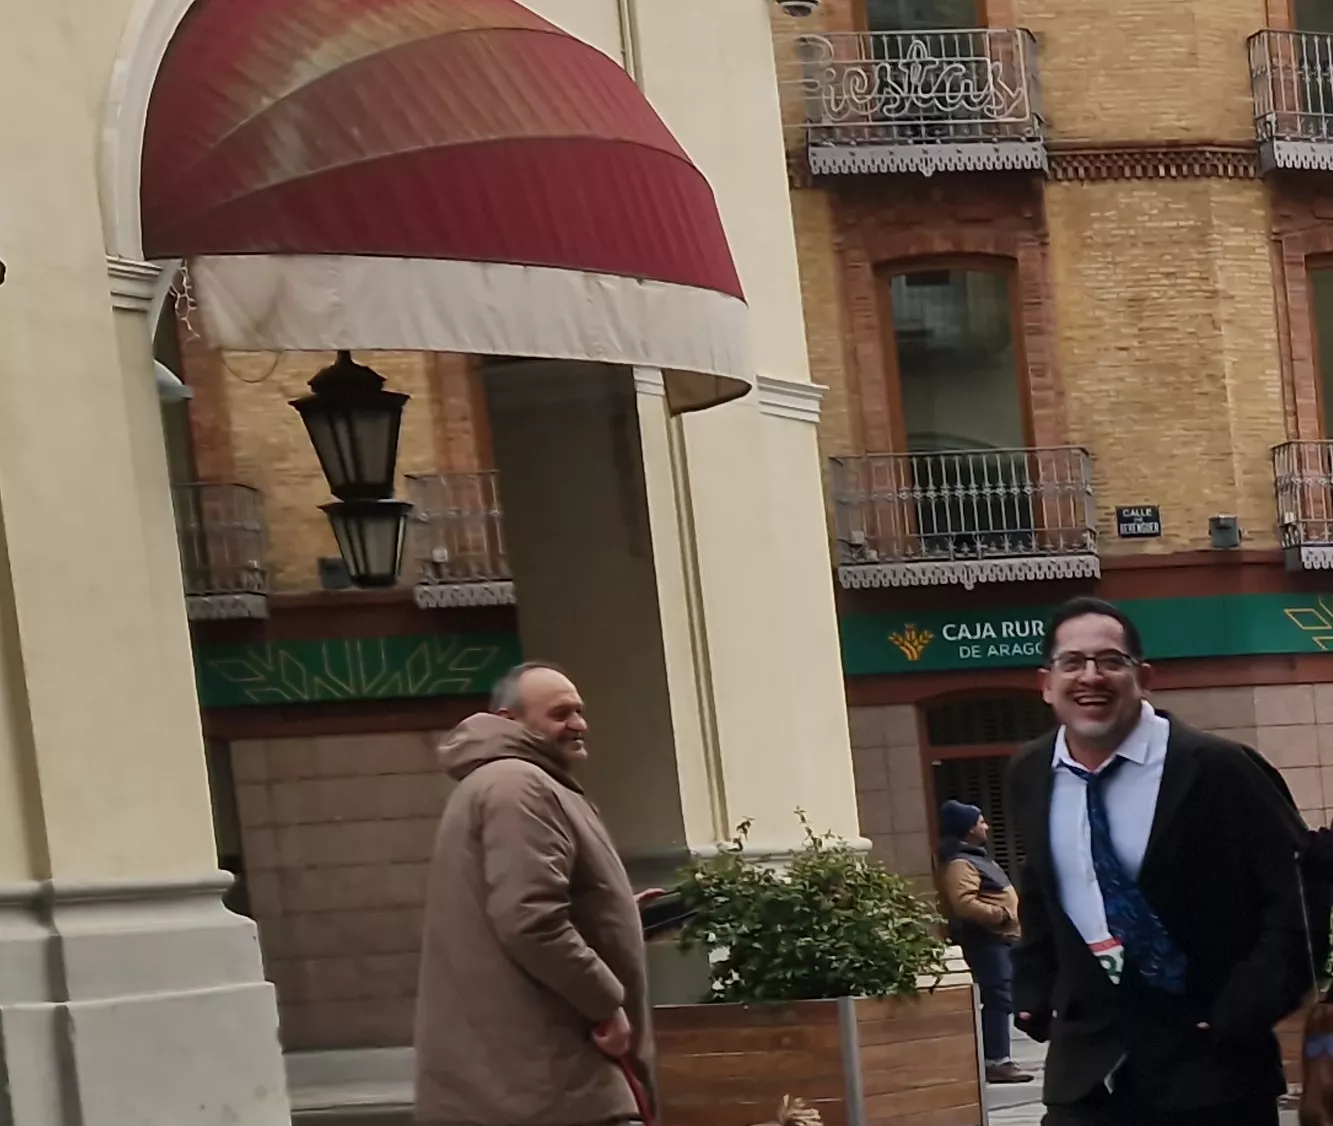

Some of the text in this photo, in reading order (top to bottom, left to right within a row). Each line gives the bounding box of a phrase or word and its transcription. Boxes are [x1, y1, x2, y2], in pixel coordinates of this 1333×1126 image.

[1122, 508, 1152, 517] CALLE
[942, 620, 1046, 641] CAJA RUR
[959, 642, 1043, 659] DE ARAG
